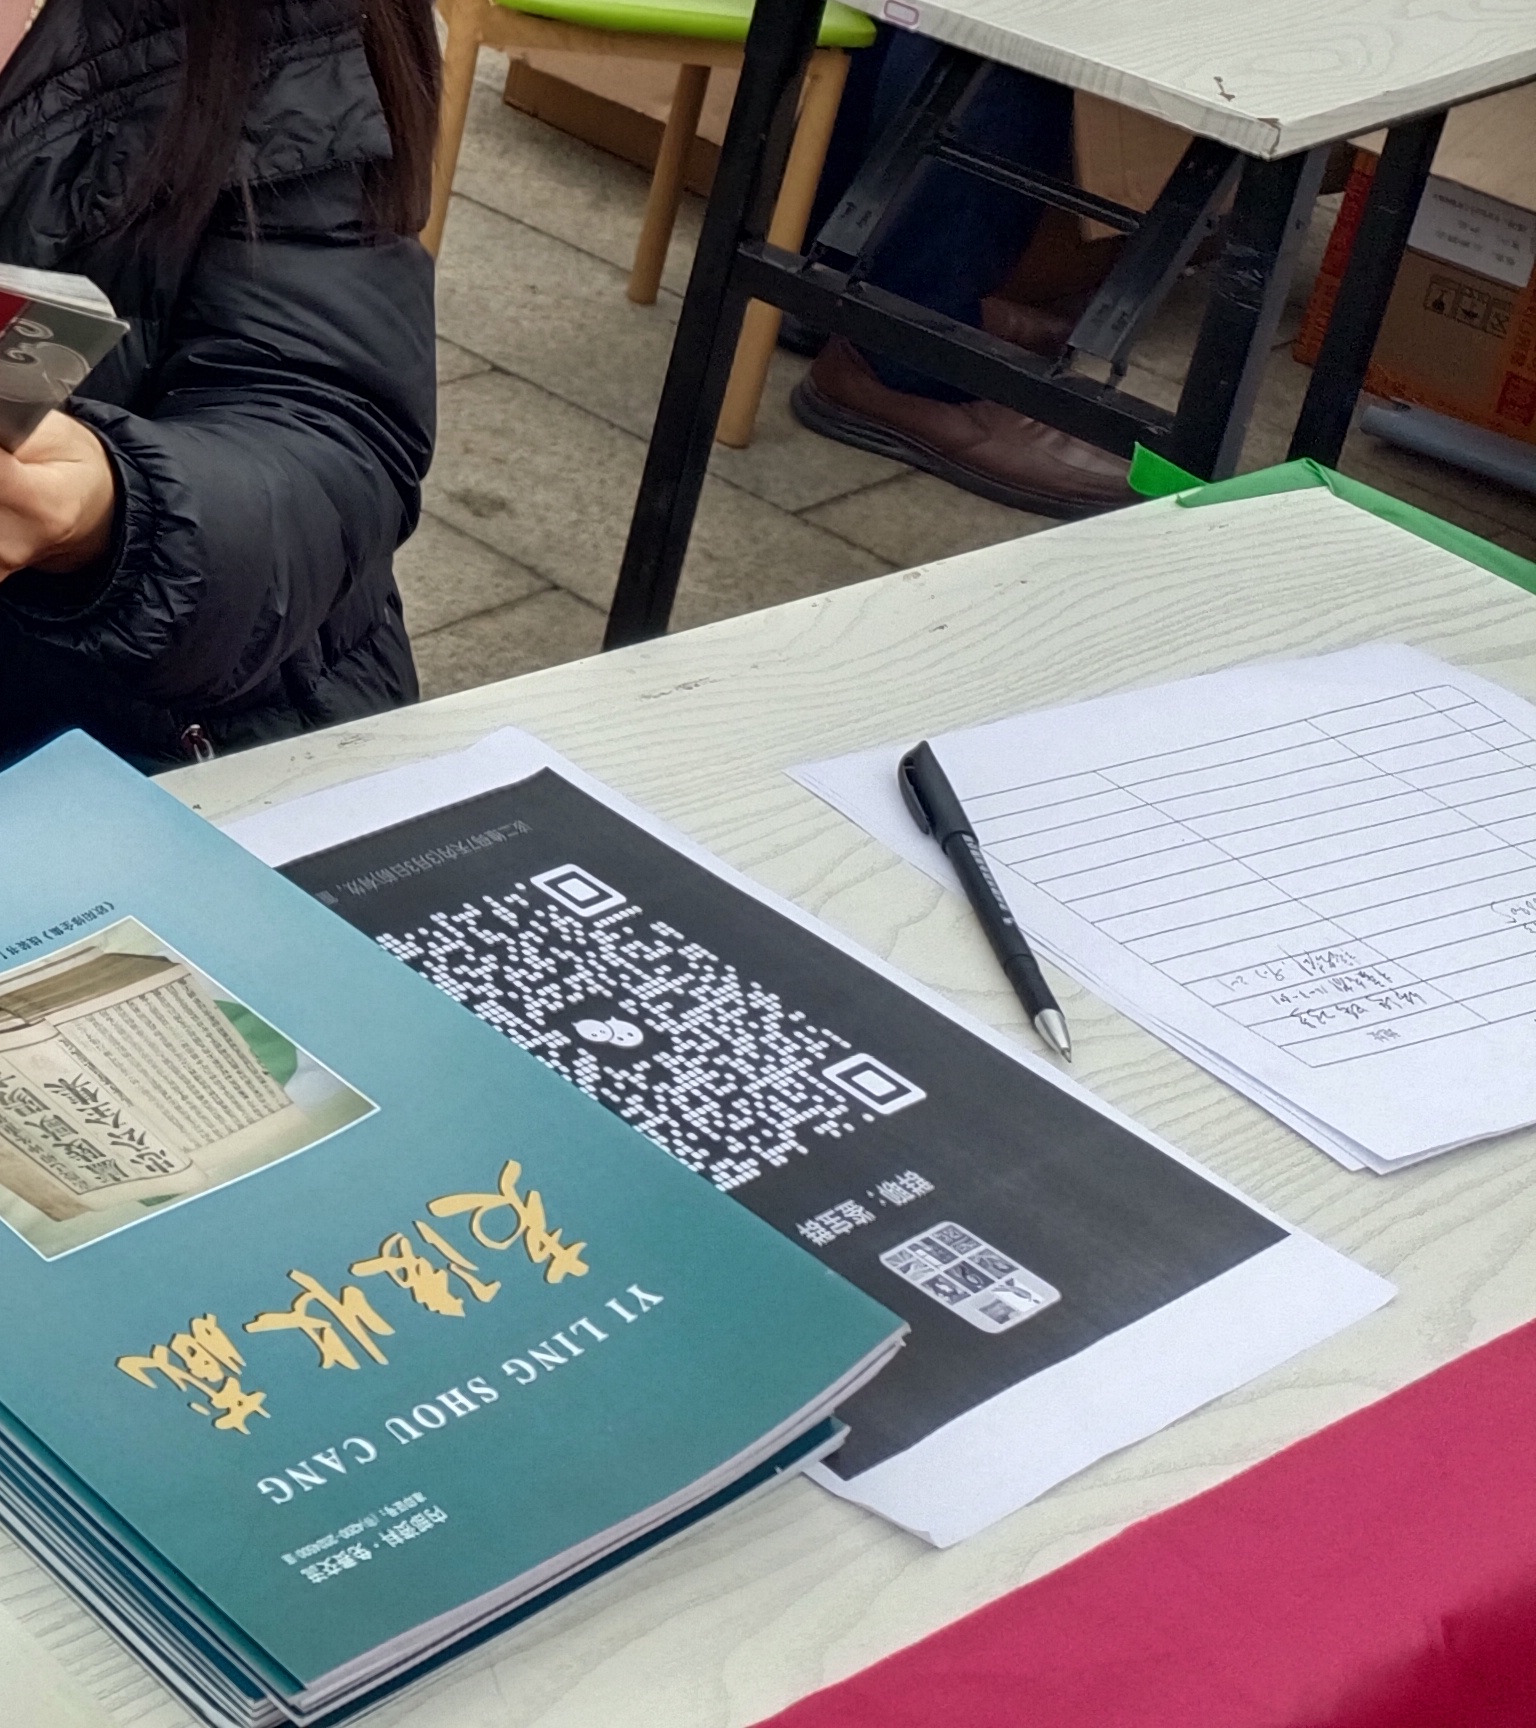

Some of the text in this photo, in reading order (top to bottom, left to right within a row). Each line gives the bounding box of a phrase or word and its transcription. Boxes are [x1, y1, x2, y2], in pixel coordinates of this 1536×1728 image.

[257, 1283, 664, 1505] YI LING SHOU CANG
